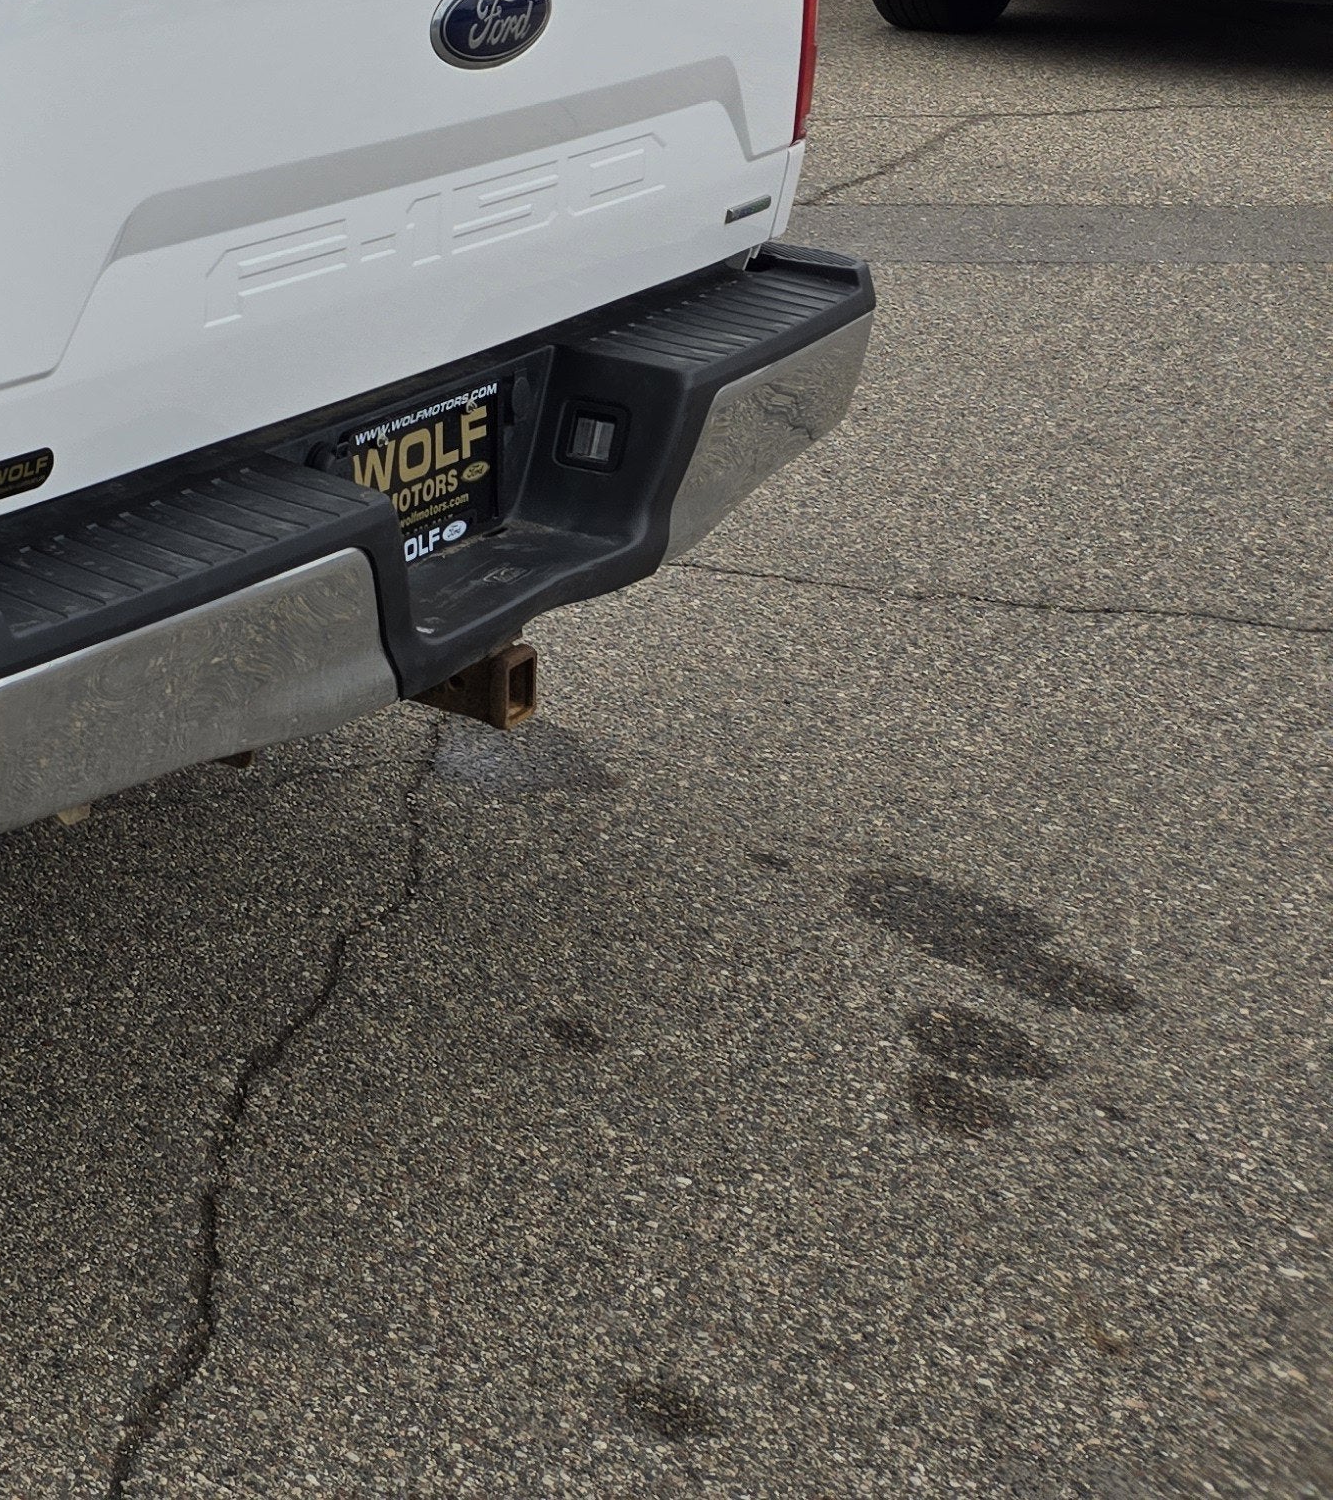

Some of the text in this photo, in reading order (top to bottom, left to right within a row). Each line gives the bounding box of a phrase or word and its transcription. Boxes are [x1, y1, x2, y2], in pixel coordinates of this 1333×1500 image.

[355, 382, 498, 446] WWW.WOLFMOTORS.COM
[352, 404, 488, 494] WOLF
[404, 527, 441, 563] OLF
